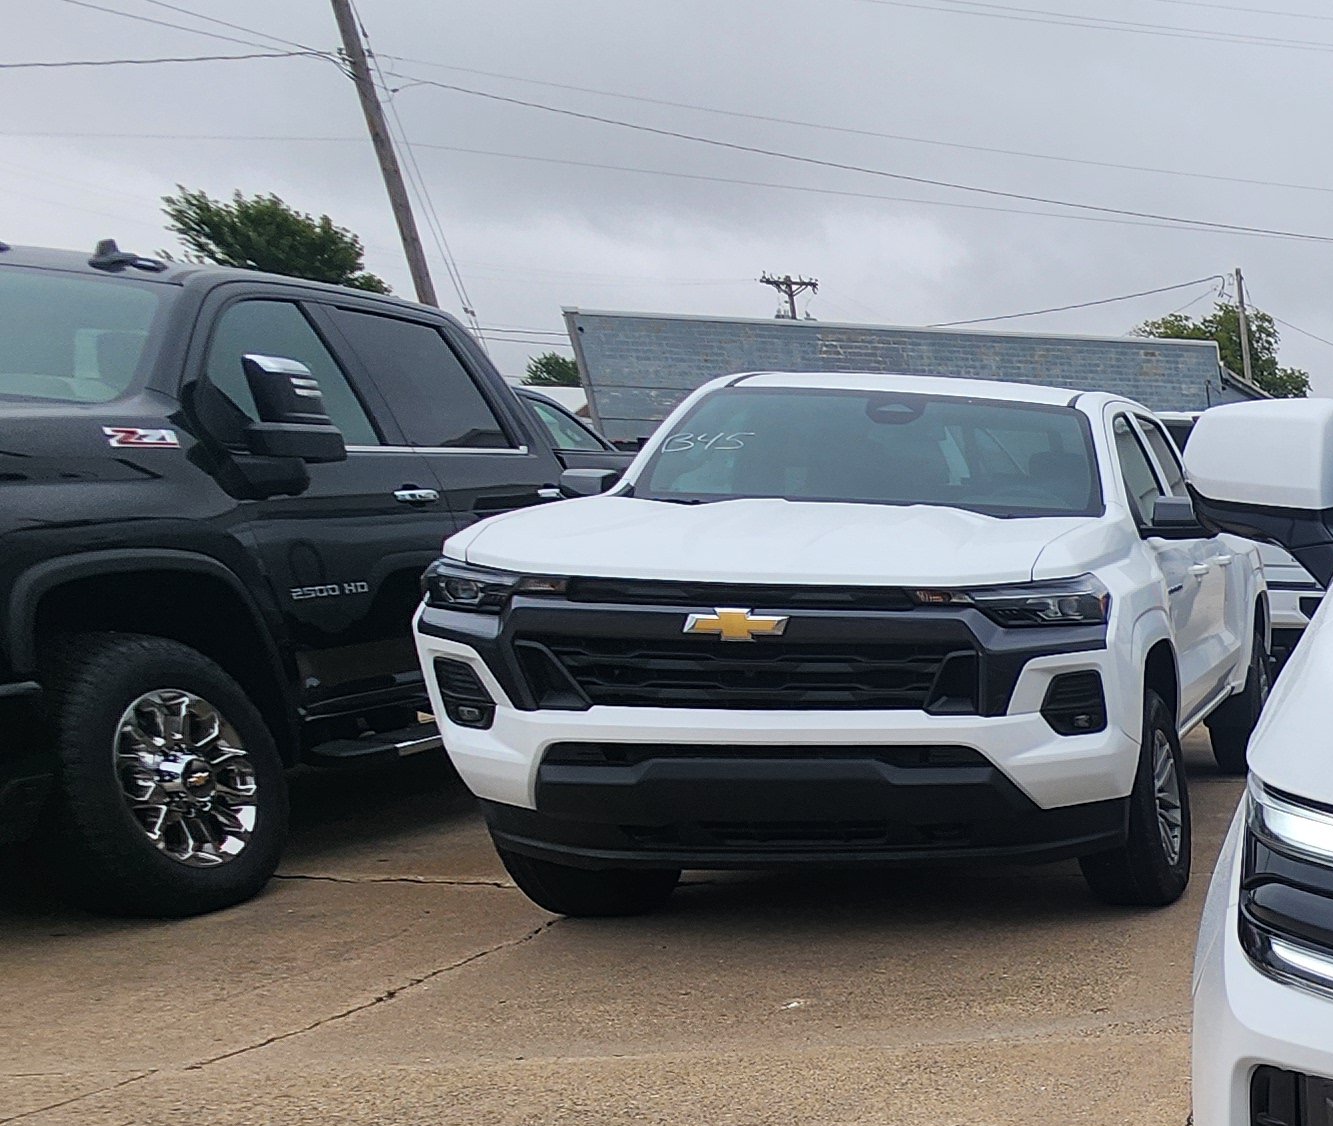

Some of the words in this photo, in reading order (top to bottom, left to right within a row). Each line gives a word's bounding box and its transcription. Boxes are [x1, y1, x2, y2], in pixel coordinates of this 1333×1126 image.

[102, 427, 181, 448] Z71
[661, 432, 756, 454] B45
[290, 584, 340, 600] 2500
[343, 581, 369, 594] HD
